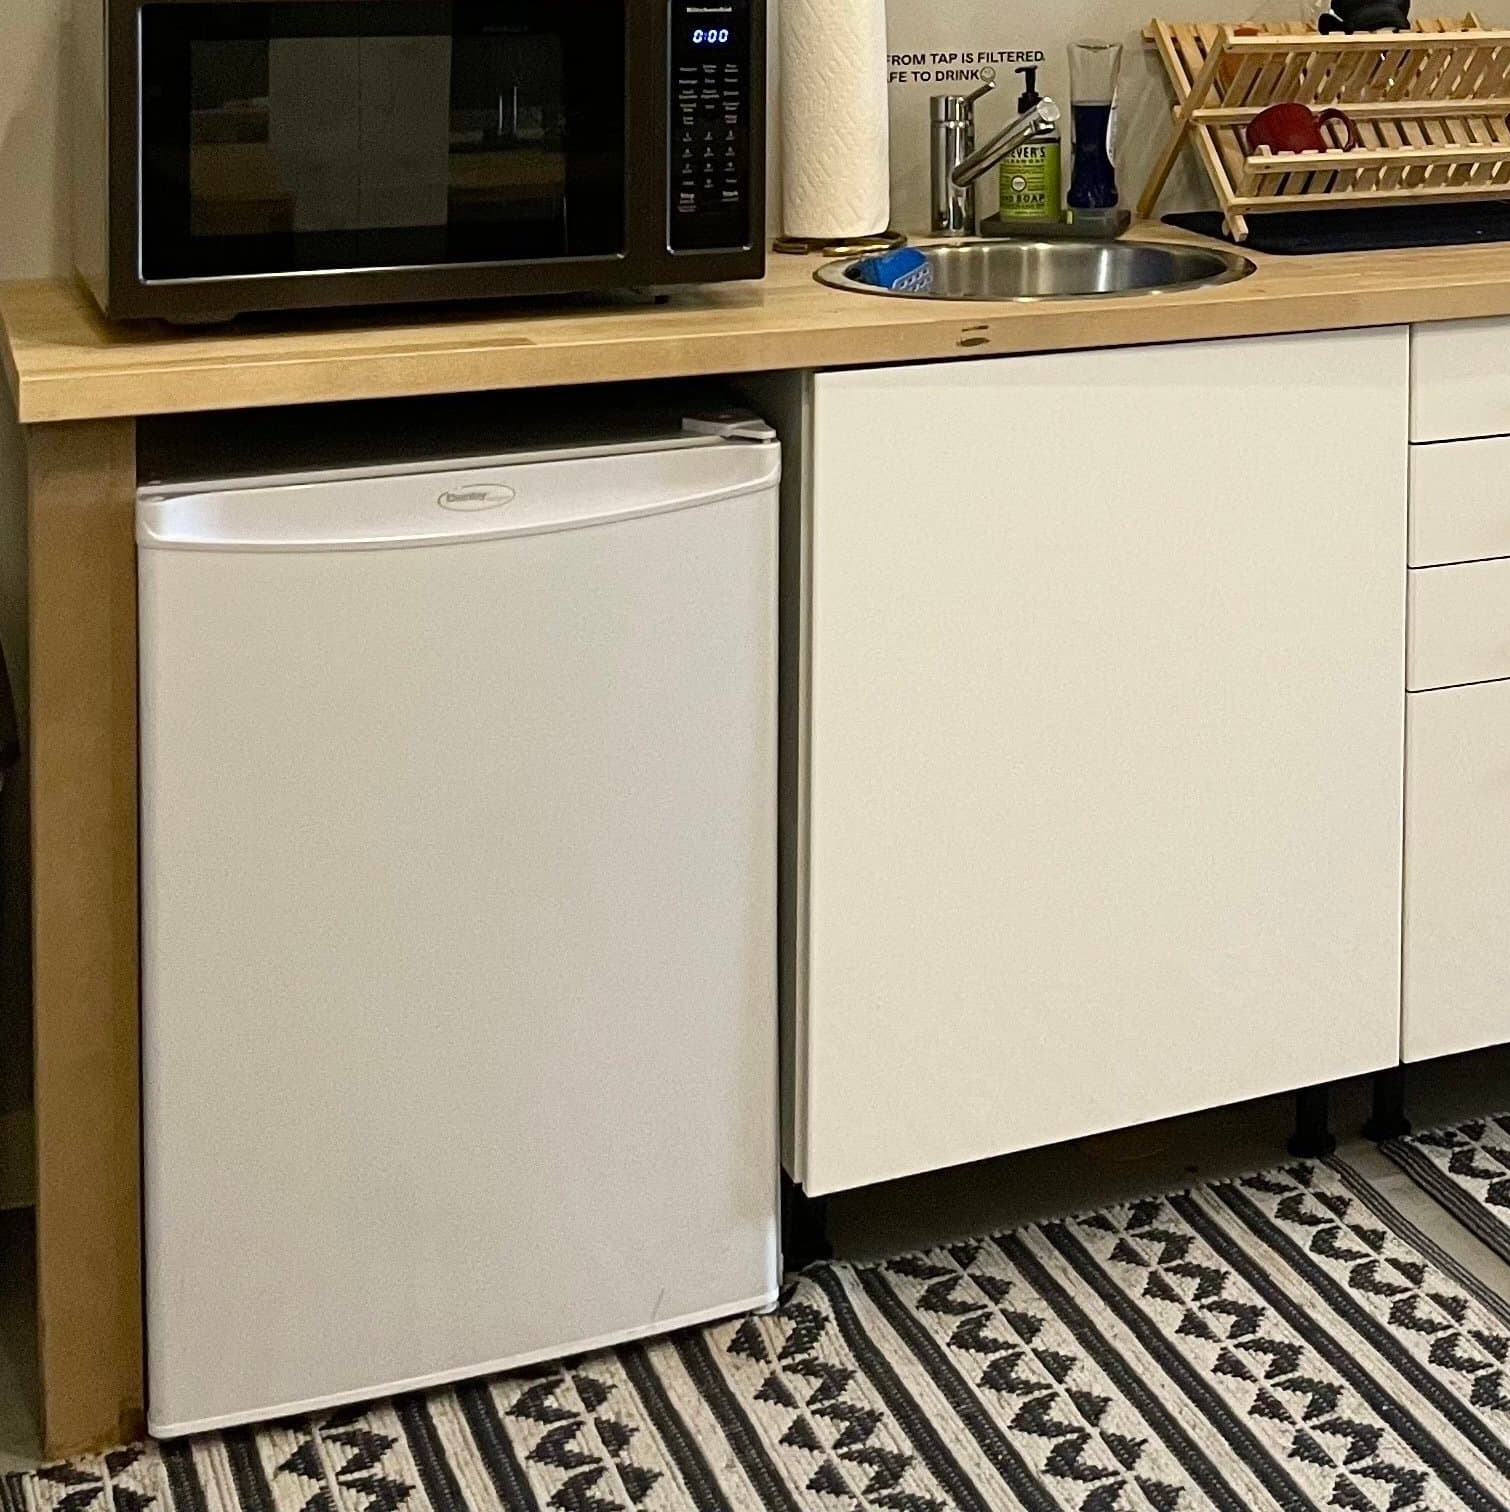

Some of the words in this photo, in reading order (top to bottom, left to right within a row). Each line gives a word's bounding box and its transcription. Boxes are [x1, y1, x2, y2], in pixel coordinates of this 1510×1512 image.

[930, 53, 958, 65] TAP
[961, 52, 974, 64] IS
[887, 71, 908, 83] FE
[910, 71, 932, 82] TO
[935, 69, 980, 82] DRINK
[1008, 146, 1046, 158] EYER'S
